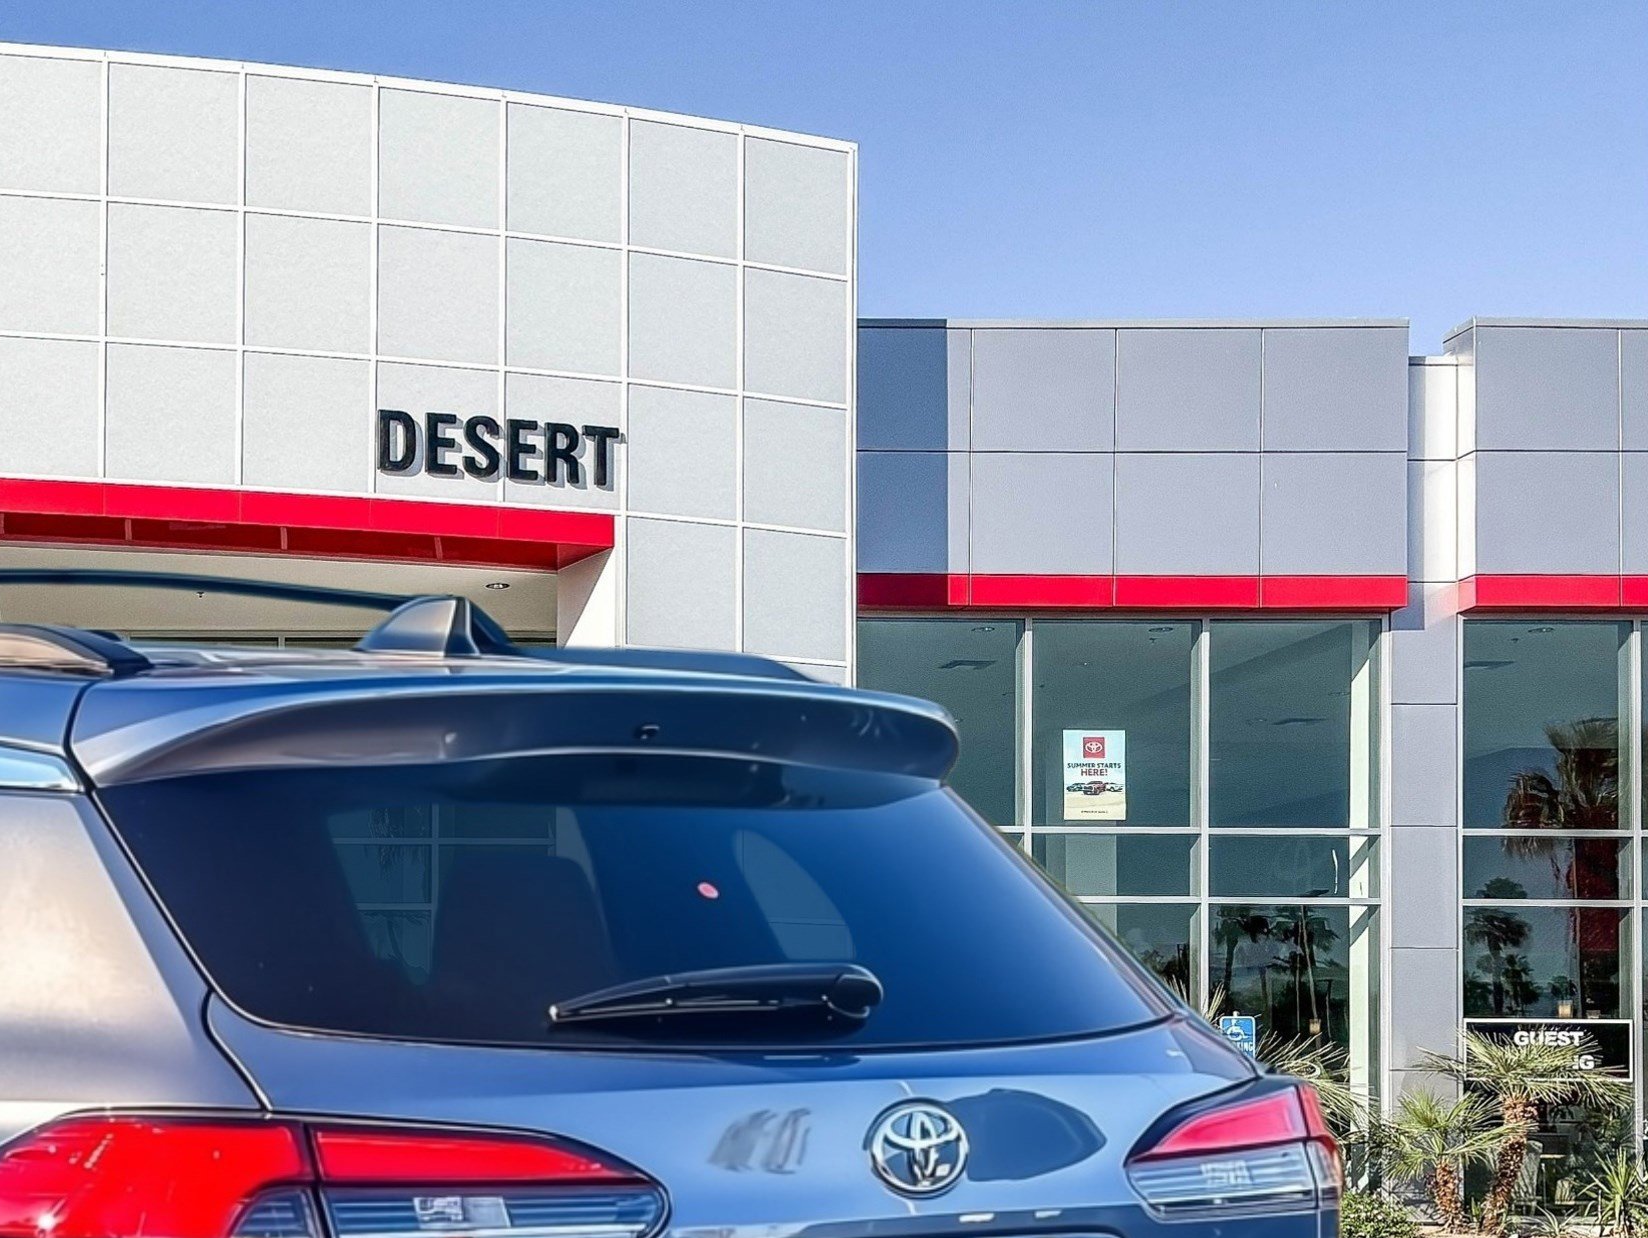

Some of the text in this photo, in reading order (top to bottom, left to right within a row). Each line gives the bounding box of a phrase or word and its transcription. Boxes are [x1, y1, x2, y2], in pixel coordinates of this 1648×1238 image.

[377, 409, 620, 487] DESERT
[1081, 768, 1108, 776] HERE!
[1513, 1031, 1584, 1047] GUEST
